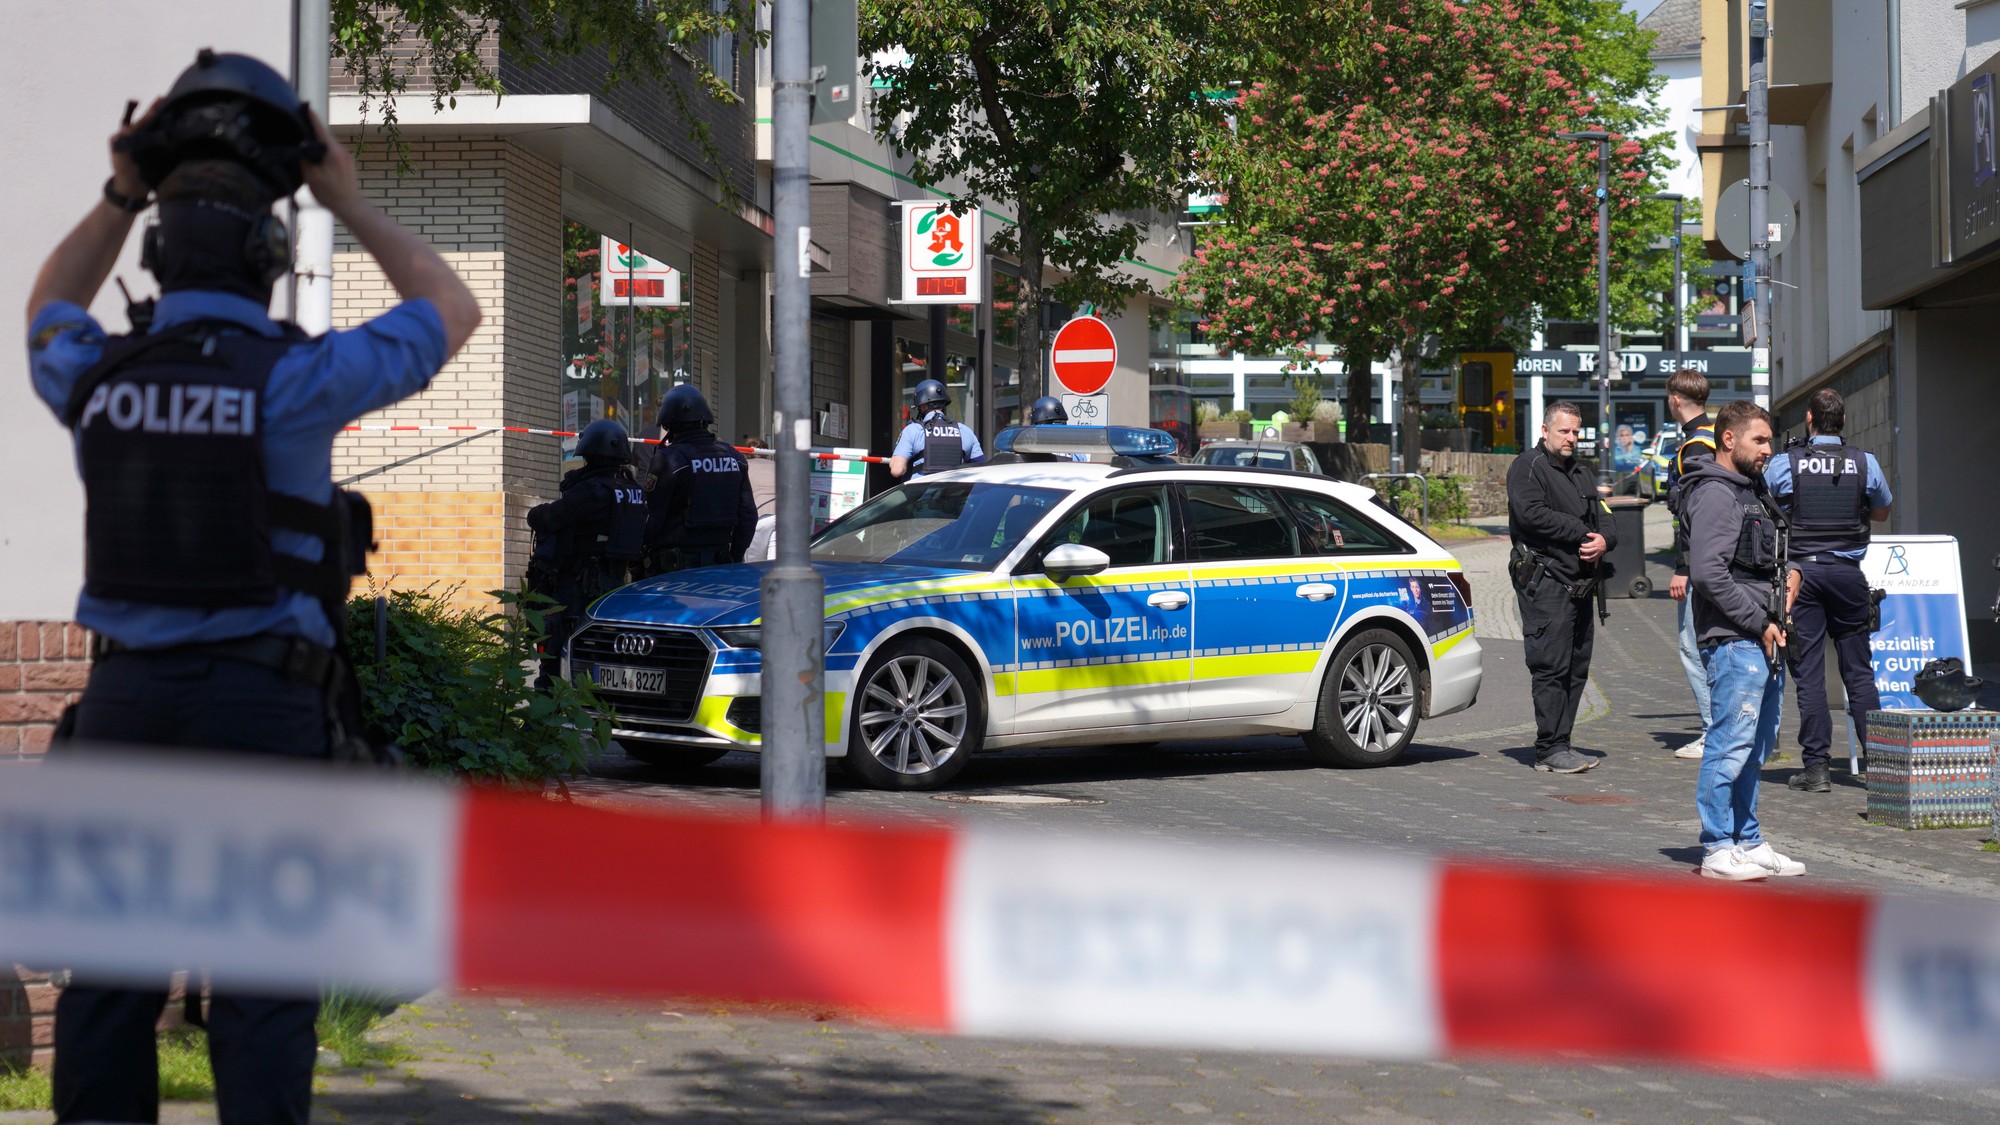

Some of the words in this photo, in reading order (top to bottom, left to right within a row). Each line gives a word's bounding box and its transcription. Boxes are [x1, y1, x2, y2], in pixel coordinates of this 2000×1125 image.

[923, 277, 965, 295] 17°C
[81, 381, 257, 436] POLIZEI
[1798, 457, 1858, 474] POLIEI
[1021, 615, 1187, 650] www.POLIZEI.rlp.de
[600, 668, 618, 688] RPL
[621, 671, 628, 689] 4
[636, 671, 664, 692] 8227
